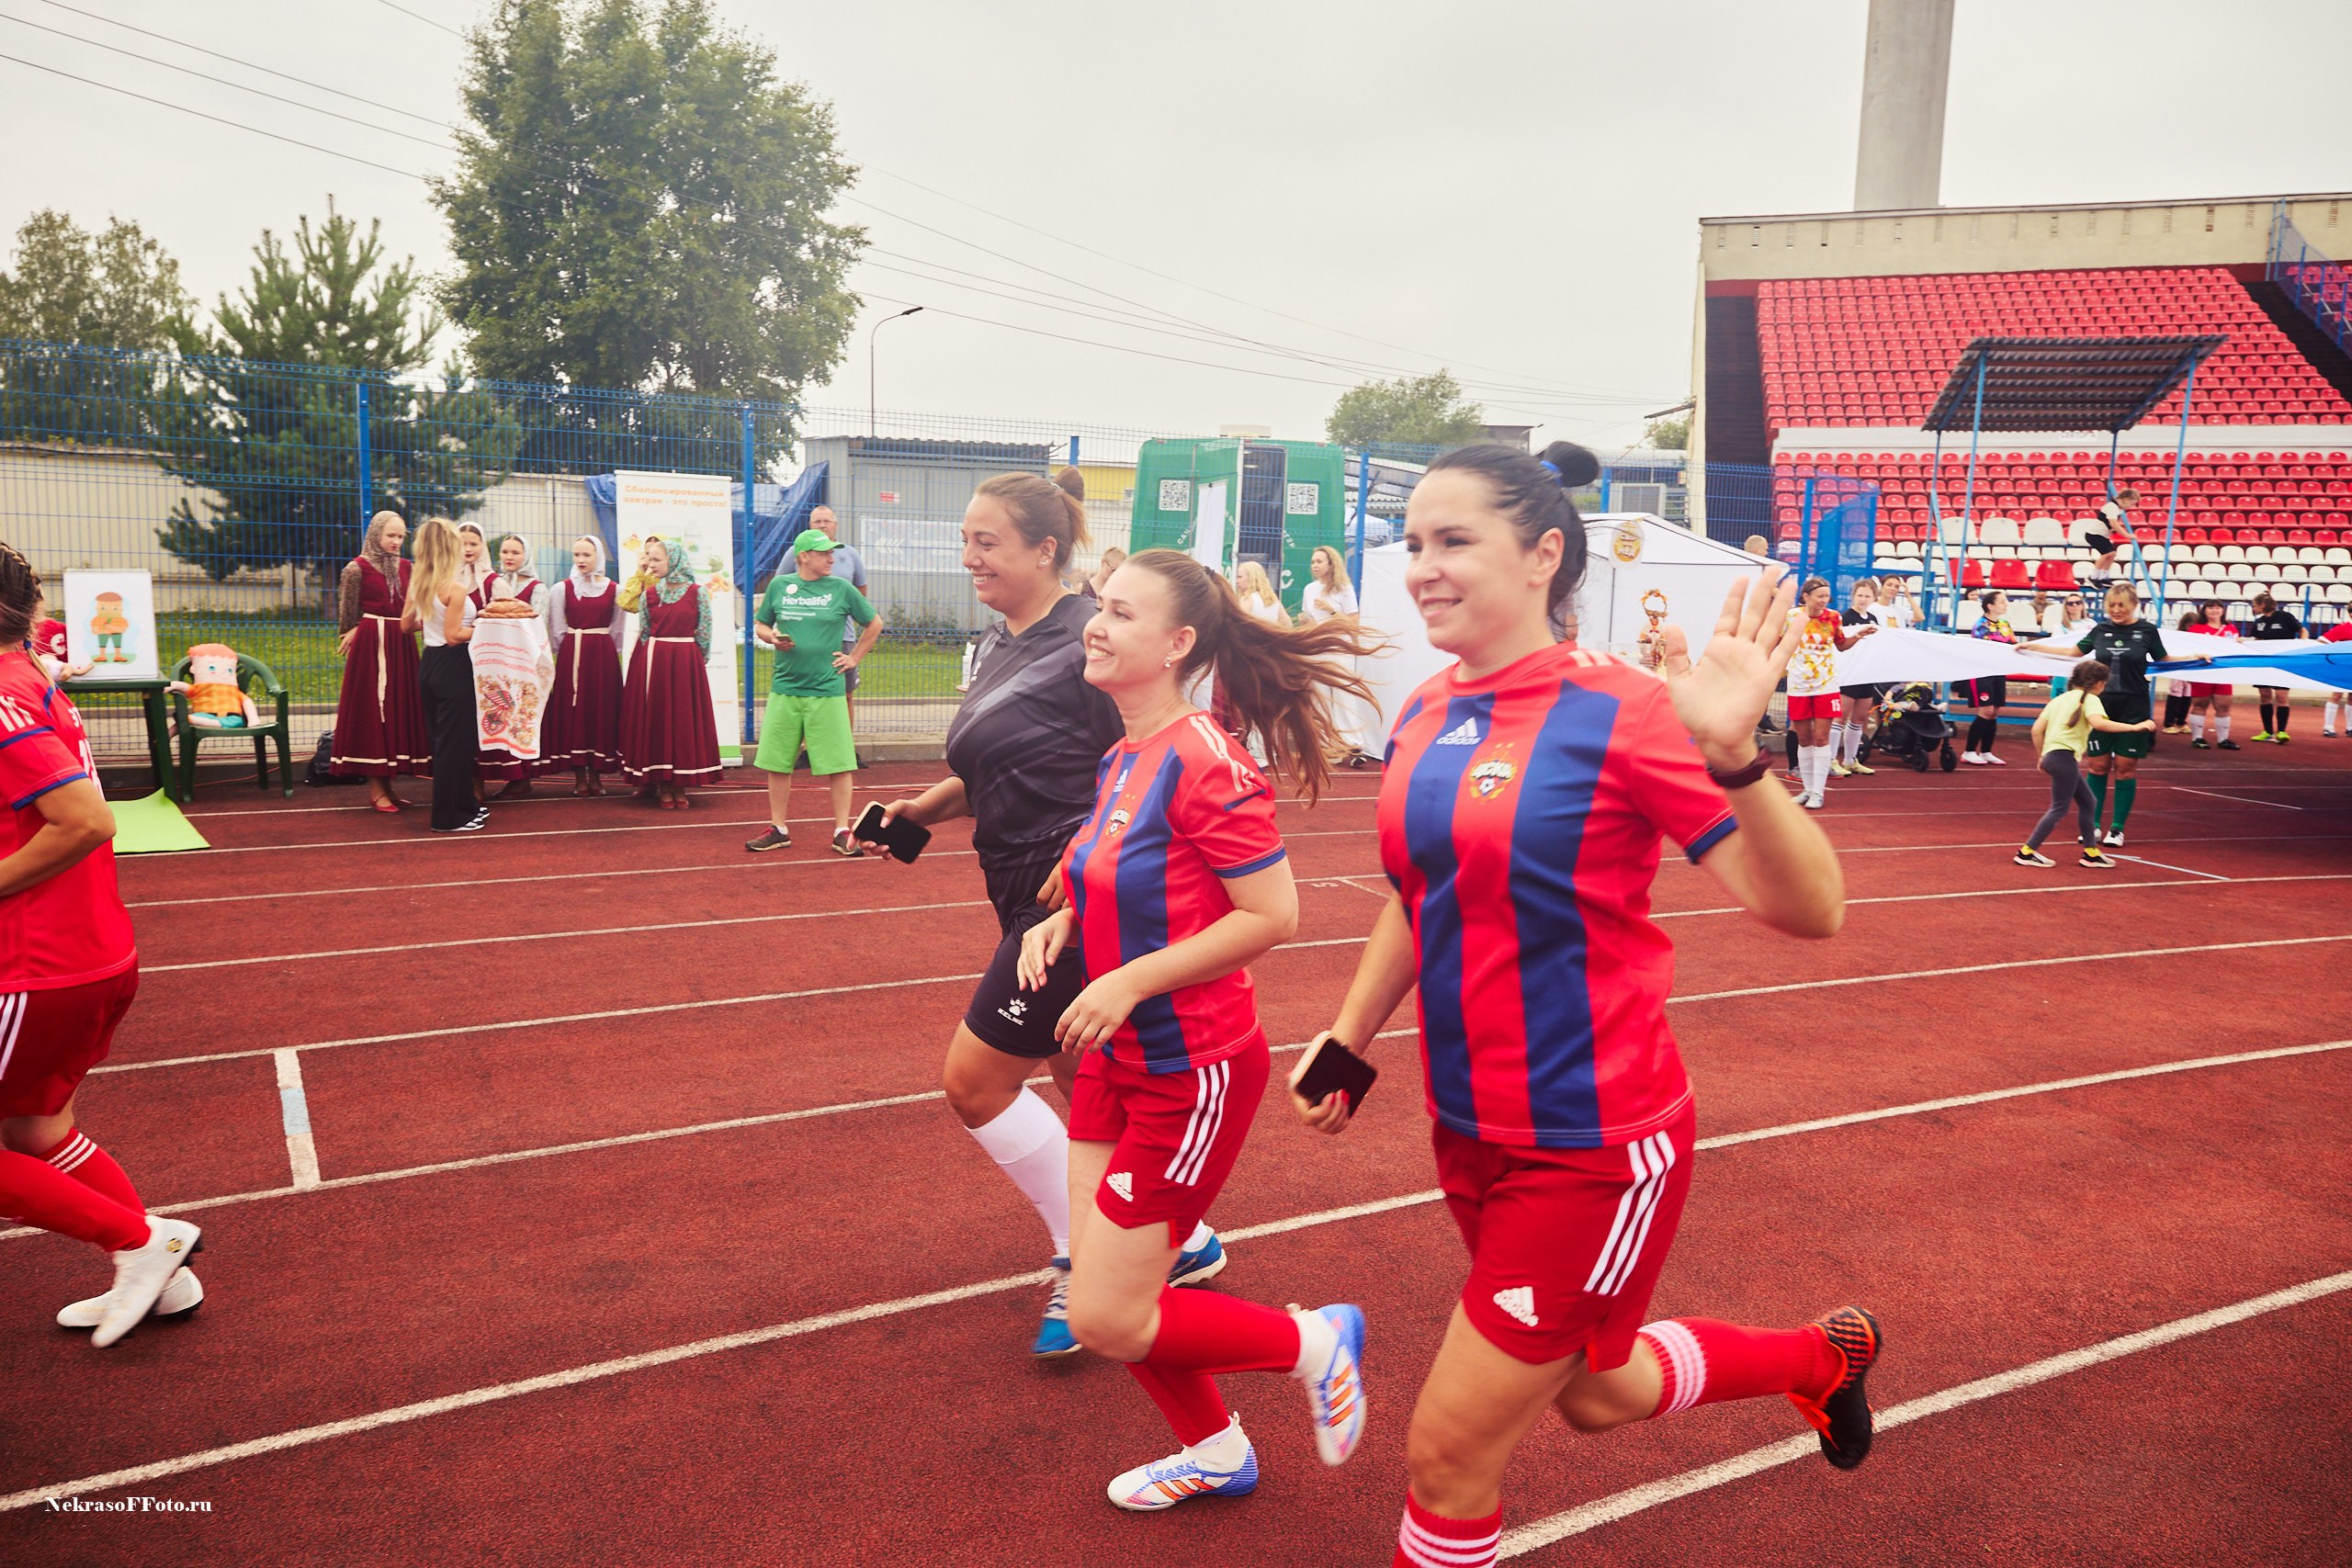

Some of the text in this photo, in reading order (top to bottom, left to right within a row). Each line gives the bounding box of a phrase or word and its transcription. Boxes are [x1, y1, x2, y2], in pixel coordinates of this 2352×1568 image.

[625, 485, 724, 497] Сбалансированный
[623, 496, 662, 504] завтрак
[783, 595, 828, 606] Herbalife
[1830, 698, 1841, 712] 15
[1436, 736, 1481, 746] adidas
[2088, 739, 2100, 751] 11
